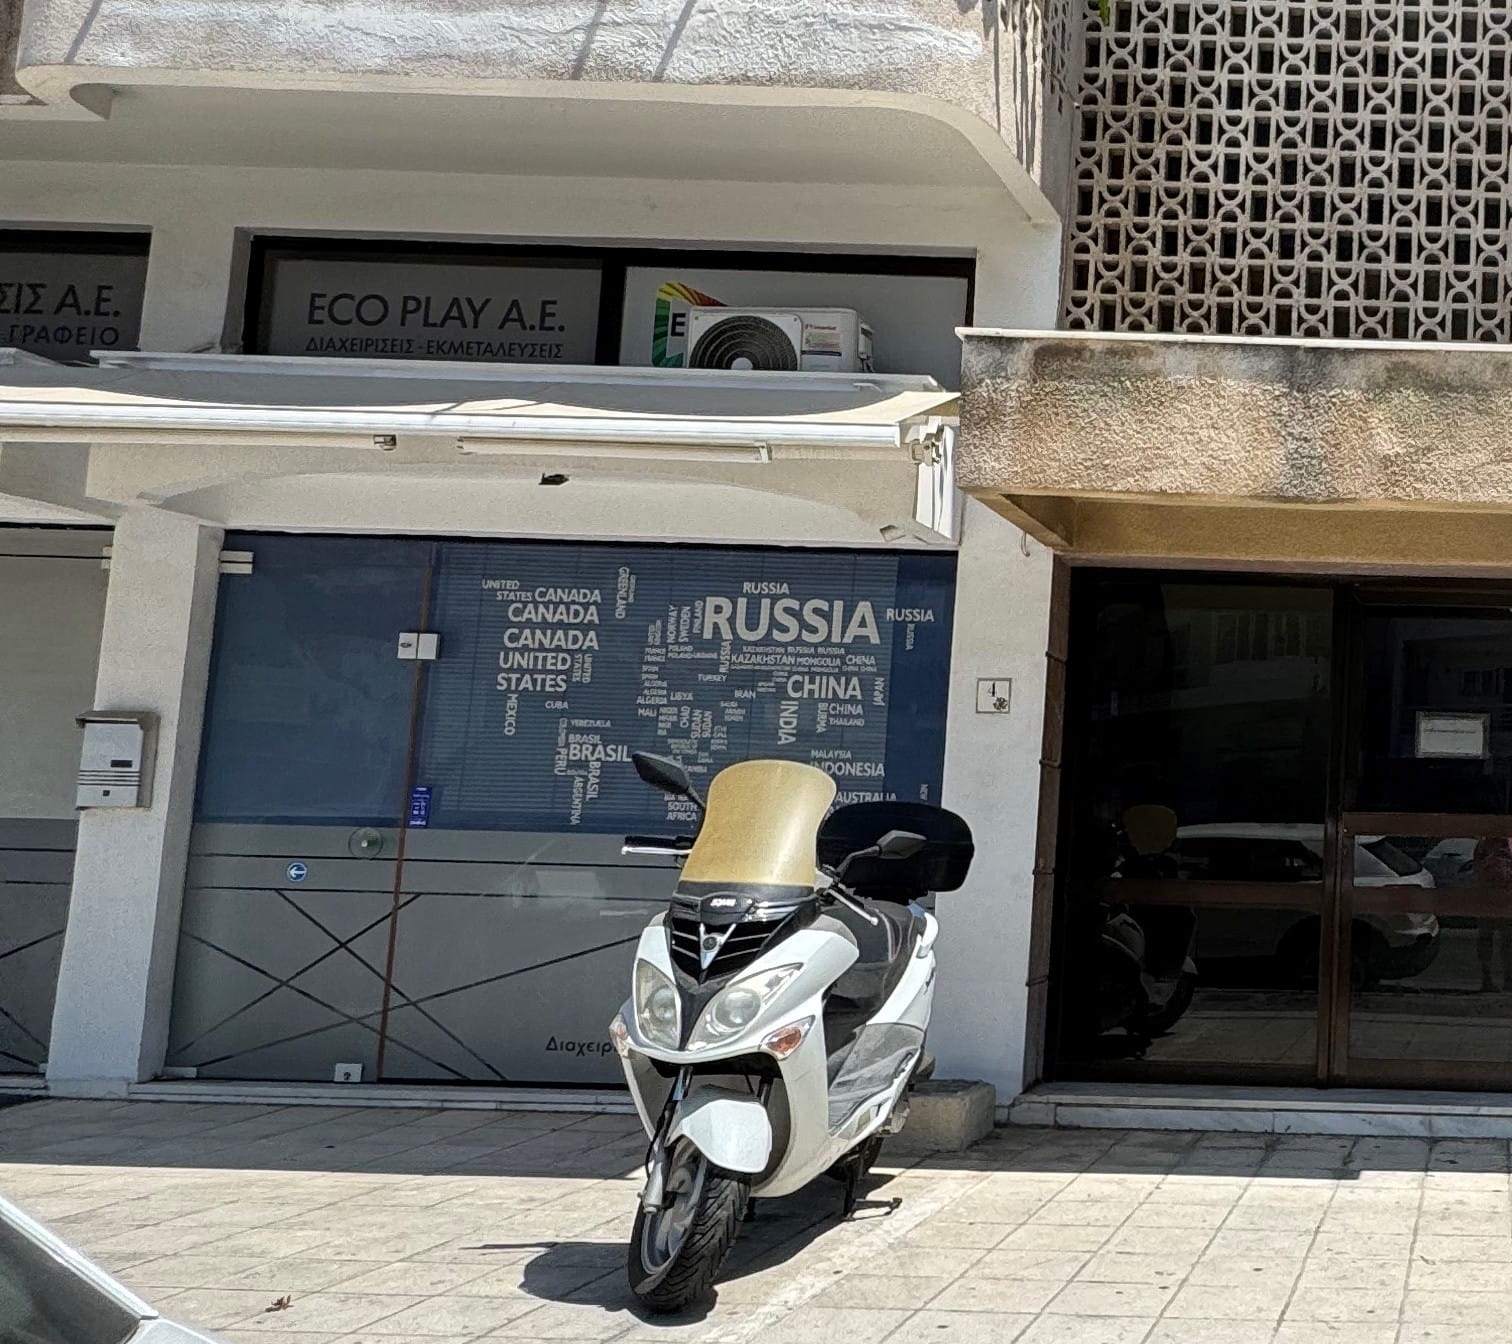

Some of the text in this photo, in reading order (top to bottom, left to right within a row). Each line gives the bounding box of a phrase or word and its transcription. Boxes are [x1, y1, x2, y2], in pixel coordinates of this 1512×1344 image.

[307, 292, 389, 327] ECO
[400, 295, 492, 329] PLAY
[8, 324, 120, 346] ΓΡΑΦΕΙΟ
[305, 336, 415, 354] ΔΙΑΧΕΙΡΙΣΕΙΣ
[426, 339, 565, 359] ΕΚΜΕΤΑΛΕΥΣΕΙΣ
[482, 580, 520, 590] UNITED
[615, 567, 630, 619] GREENLAND
[743, 582, 790, 595] RUSSIA
[496, 587, 601, 603] STATES CANADA
[508, 603, 600, 624] CANADA
[703, 596, 881, 644] RUSSIA
[886, 608, 935, 623] RUSSIA
[503, 628, 599, 650] CANADA
[499, 651, 571, 670] UNITED
[731, 654, 796, 665] KAZAKHSTAN
[845, 655, 876, 665] CHINA
[496, 673, 567, 692] STATES
[787, 674, 862, 700] CHINA
[872, 677, 885, 706] JAPAN
[545, 701, 568, 709] CUBA
[828, 704, 864, 716] CHINA
[504, 694, 519, 736] MEXICO
[777, 700, 799, 745] INDIA
[568, 734, 602, 744] BRASIL
[554, 748, 568, 776] PERU
[569, 744, 633, 762] BRASIL
[586, 761, 601, 801] BRASIL
[668, 802, 698, 811] SOUTH
[835, 792, 897, 804] AUSTRALIA
[666, 812, 697, 821] AFRICA
